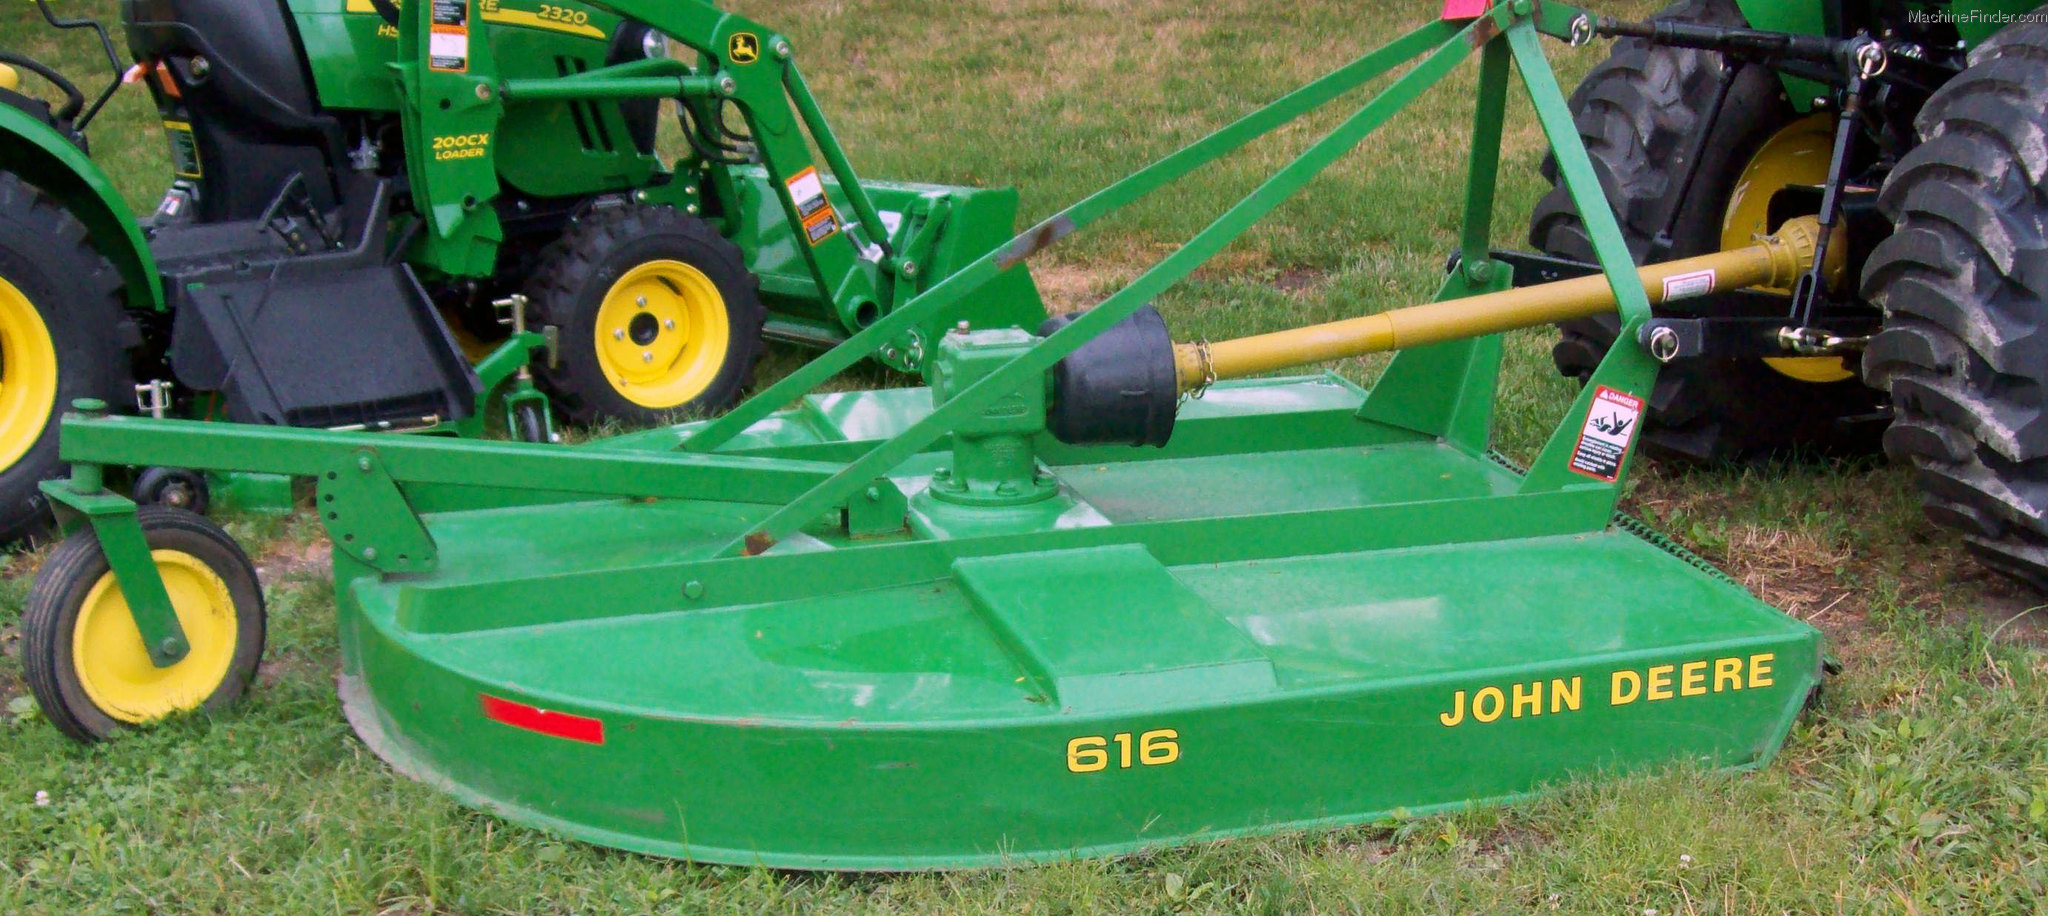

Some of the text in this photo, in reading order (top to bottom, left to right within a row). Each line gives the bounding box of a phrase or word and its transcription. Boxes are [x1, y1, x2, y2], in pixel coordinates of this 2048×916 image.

[539, 4, 588, 25] 2320
[432, 133, 489, 149] 200CX
[435, 147, 485, 160] LOADER
[1608, 391, 1639, 408] DANGER
[1439, 652, 1775, 727] JOHN DEERE
[1067, 728, 1179, 773] 616
